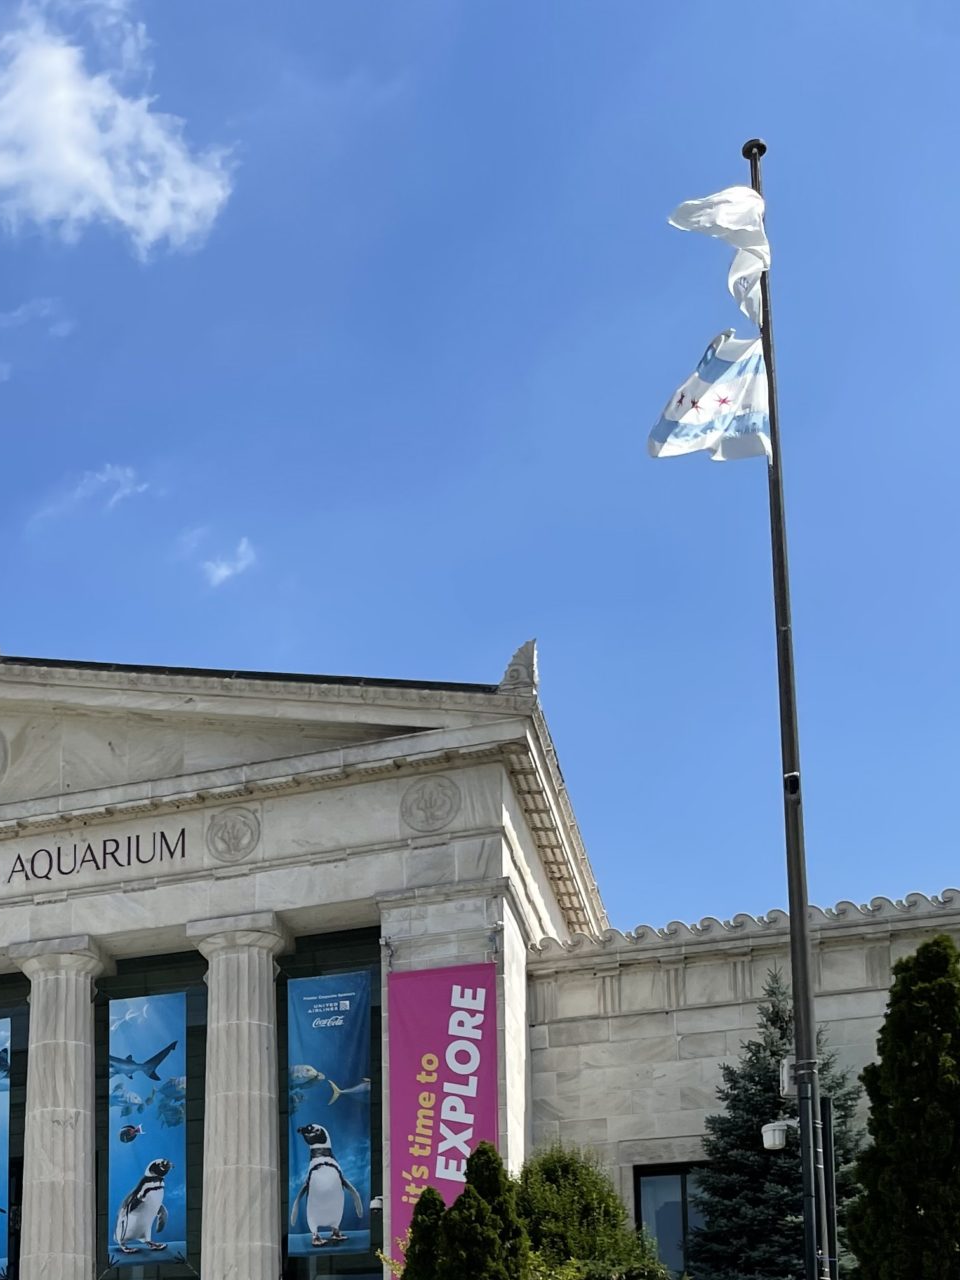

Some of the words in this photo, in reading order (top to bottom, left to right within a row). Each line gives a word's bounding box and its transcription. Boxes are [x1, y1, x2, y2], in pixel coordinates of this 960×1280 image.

[7, 827, 186, 883] AQUARIUM
[416, 1053, 439, 1084] to
[435, 984, 487, 1183] EXPLORE
[408, 1091, 436, 1158] time
